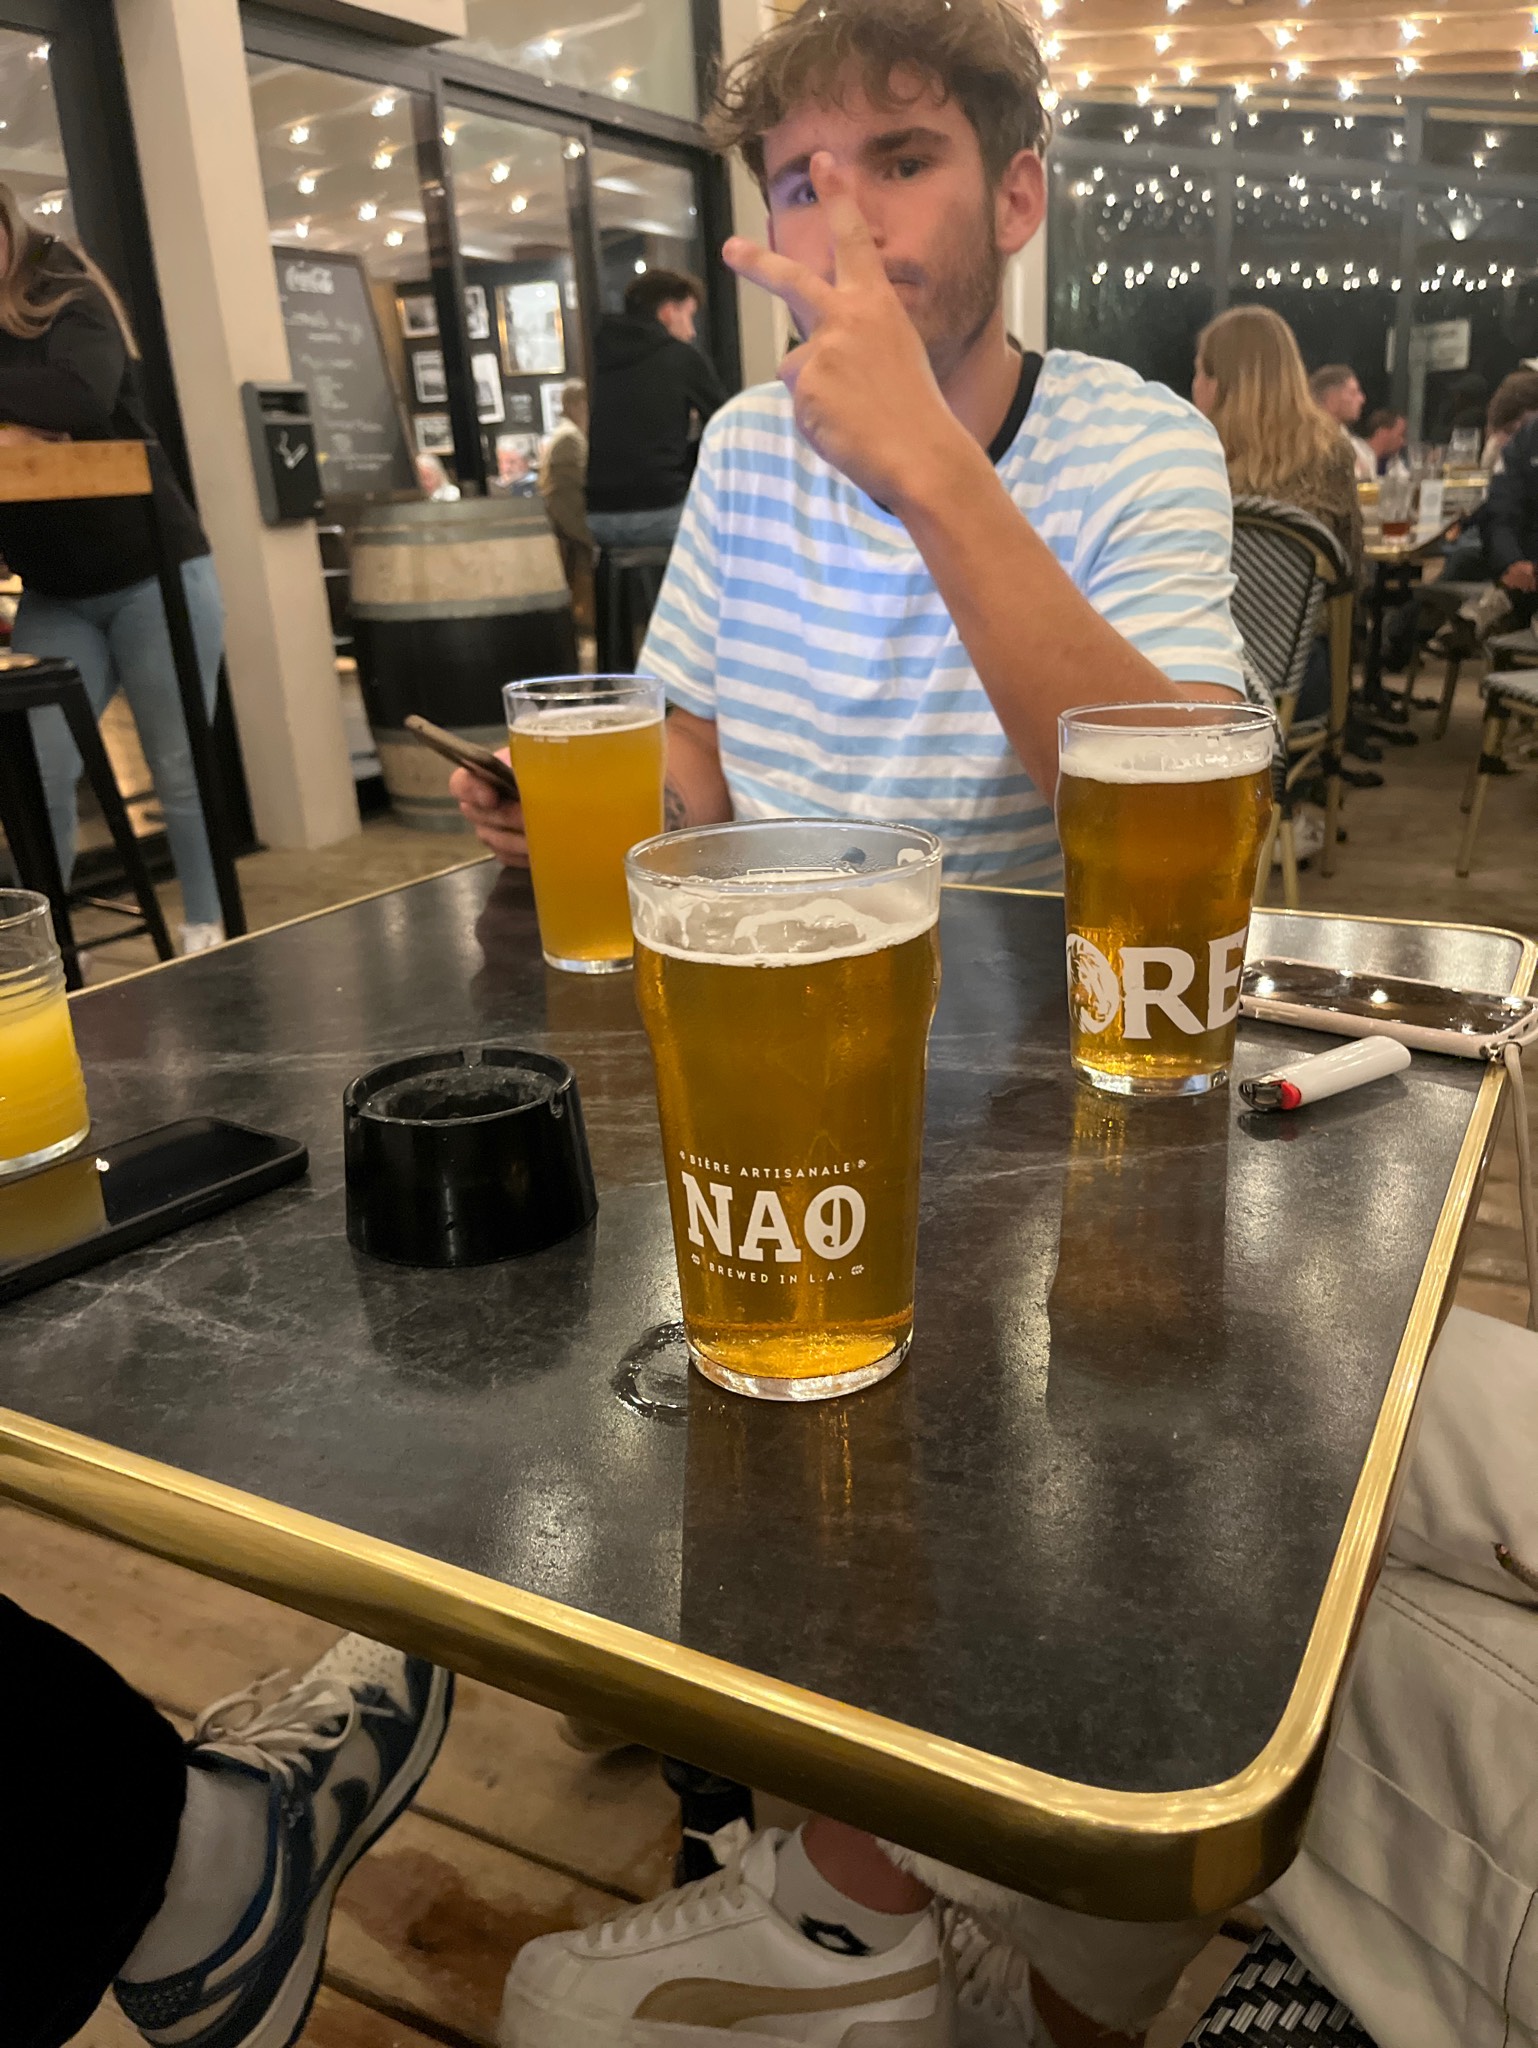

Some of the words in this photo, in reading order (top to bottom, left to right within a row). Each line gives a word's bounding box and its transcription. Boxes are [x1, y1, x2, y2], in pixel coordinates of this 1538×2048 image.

[689, 1154, 730, 1174] BIÈRE
[740, 1162, 850, 1178] ARTISANALE
[681, 1170, 866, 1264] NAO
[709, 1262, 768, 1283] BREWED
[780, 1274, 798, 1285] IN
[809, 1271, 843, 1284] L.A.
